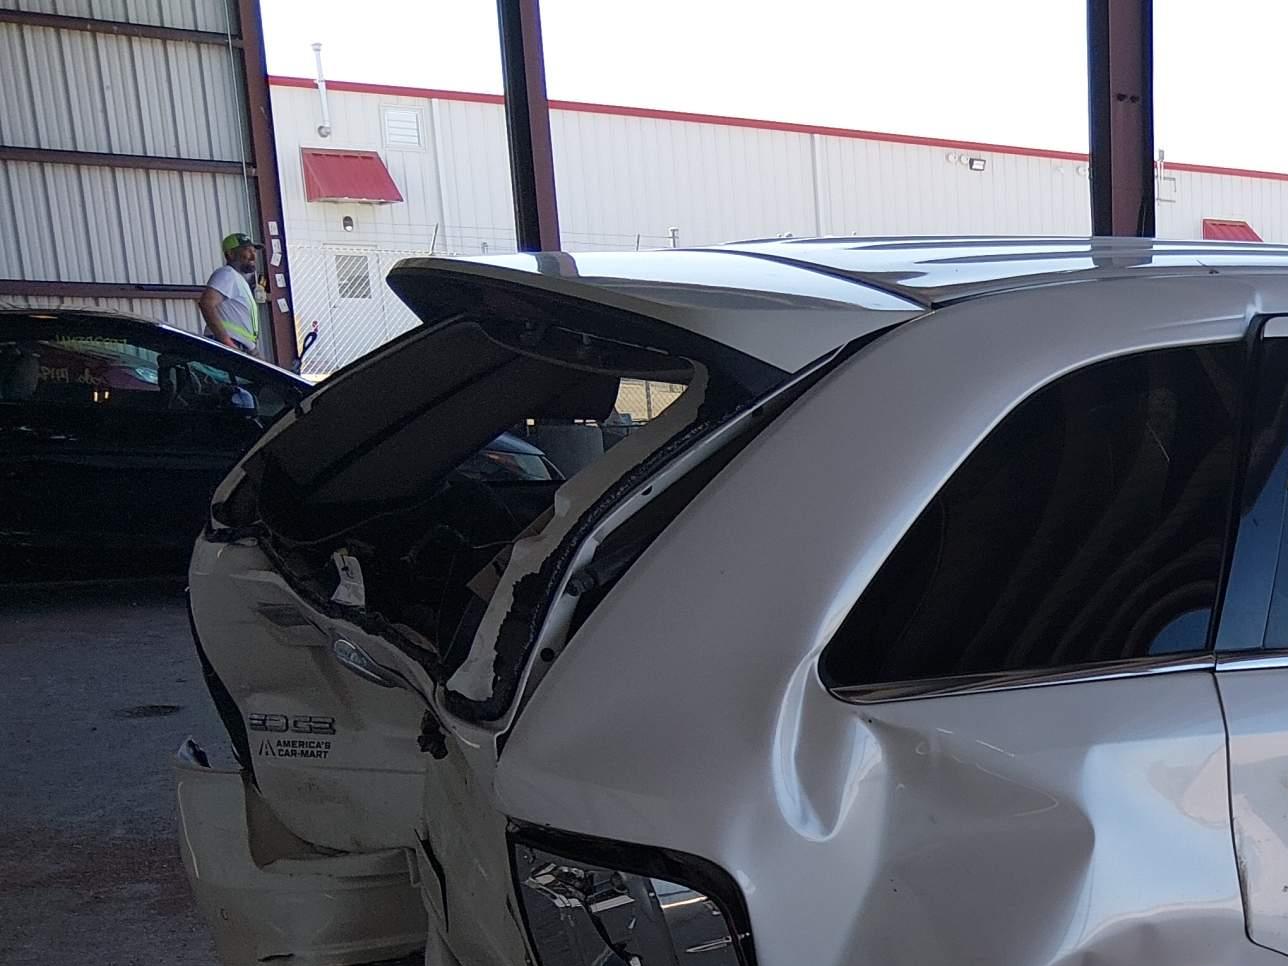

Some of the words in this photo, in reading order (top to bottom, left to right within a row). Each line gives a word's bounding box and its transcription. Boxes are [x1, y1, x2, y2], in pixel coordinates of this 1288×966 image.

[248, 712, 337, 735] EDGE
[276, 739, 331, 749] AMERICA'S
[277, 748, 329, 759] CAR-MART
